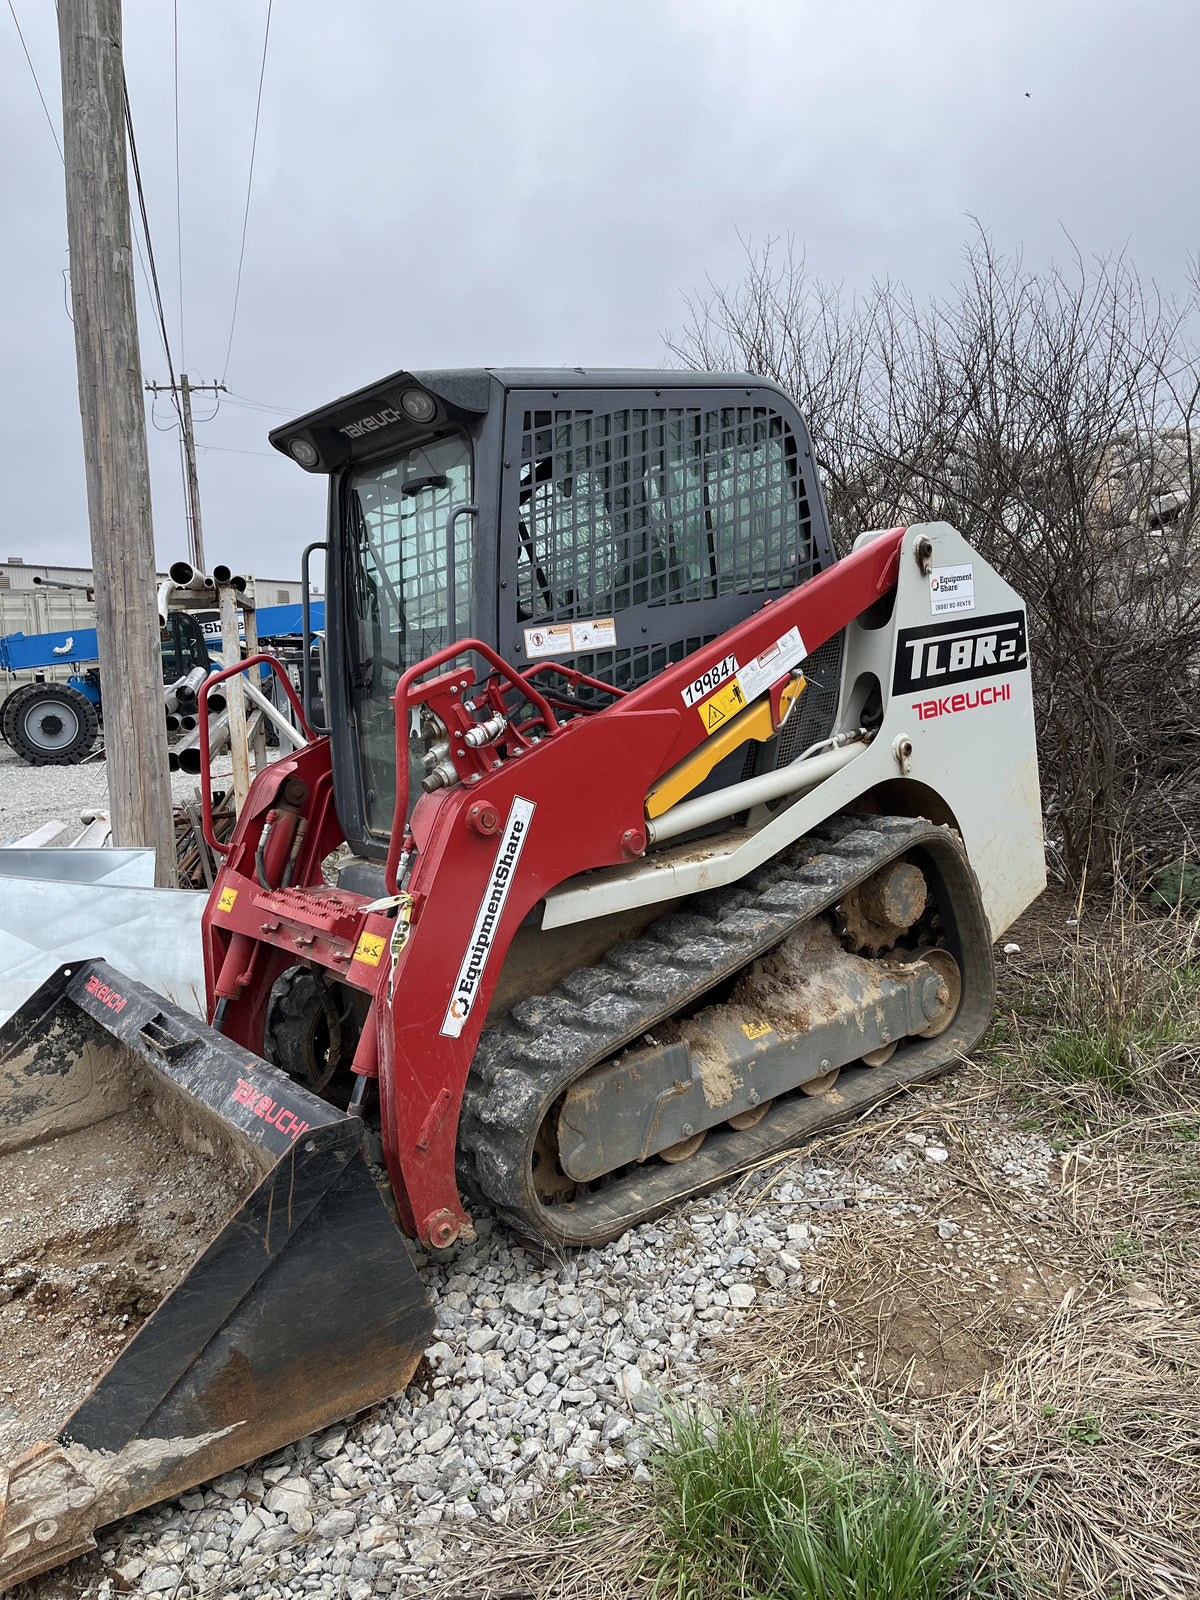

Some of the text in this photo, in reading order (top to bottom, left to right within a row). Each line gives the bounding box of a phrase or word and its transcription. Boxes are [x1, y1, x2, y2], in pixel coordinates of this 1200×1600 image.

[939, 573, 972, 584] Equipment
[940, 584, 959, 593] Share
[905, 622, 1020, 680] TL8R2
[685, 653, 737, 704] 199847
[458, 820, 525, 995] EquipmentShare
